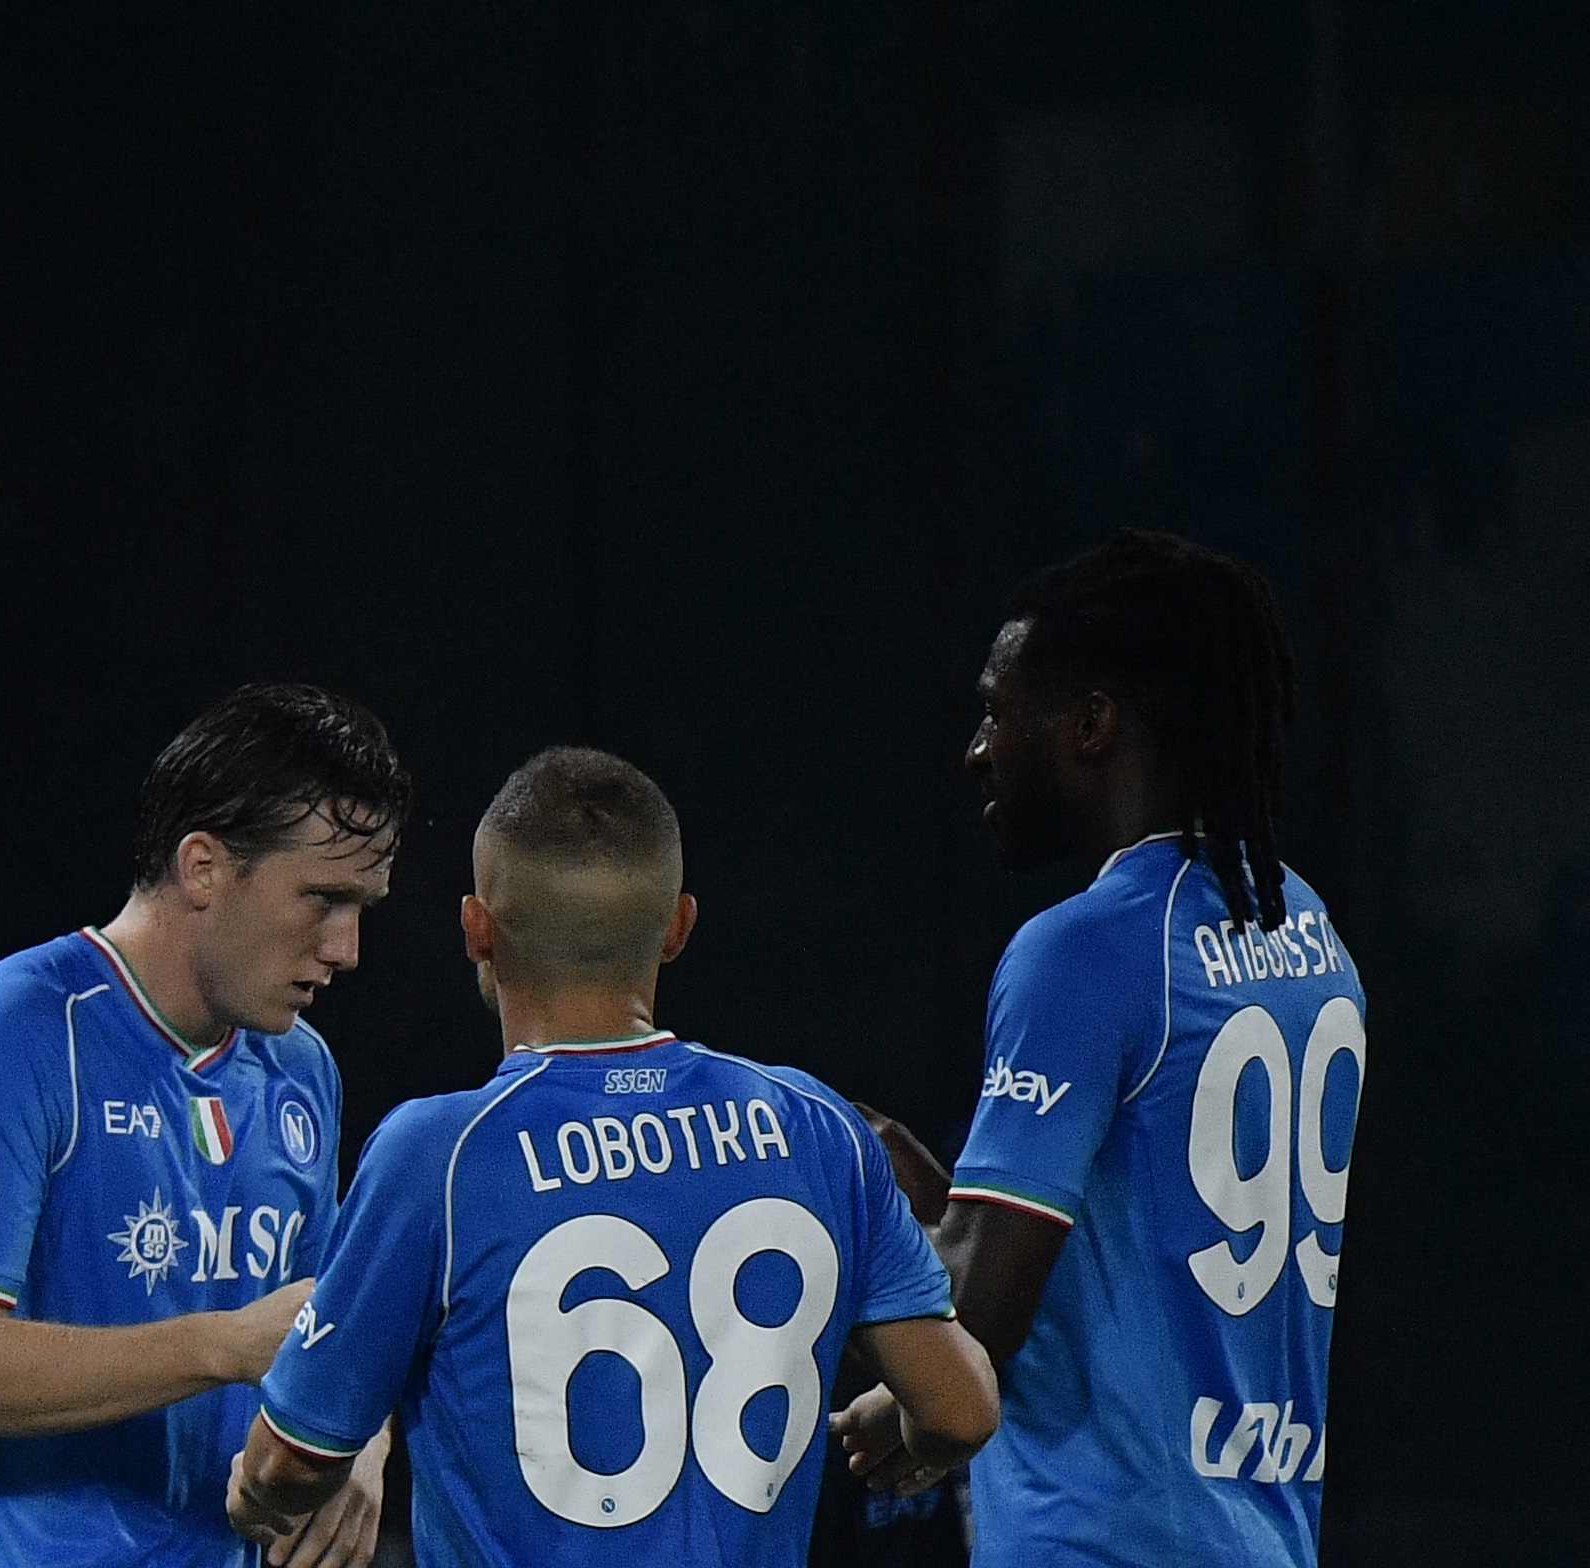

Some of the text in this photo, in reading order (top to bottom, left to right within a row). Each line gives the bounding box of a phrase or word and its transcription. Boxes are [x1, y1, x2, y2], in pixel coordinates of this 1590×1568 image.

[605, 1068, 668, 1093] SSCN
[981, 1056, 1072, 1115] ebay
[103, 1100, 162, 1139] EA7
[518, 1098, 790, 1193] LOBOTKA
[1189, 997, 1367, 1316] 99
[506, 1198, 841, 1529] 68
